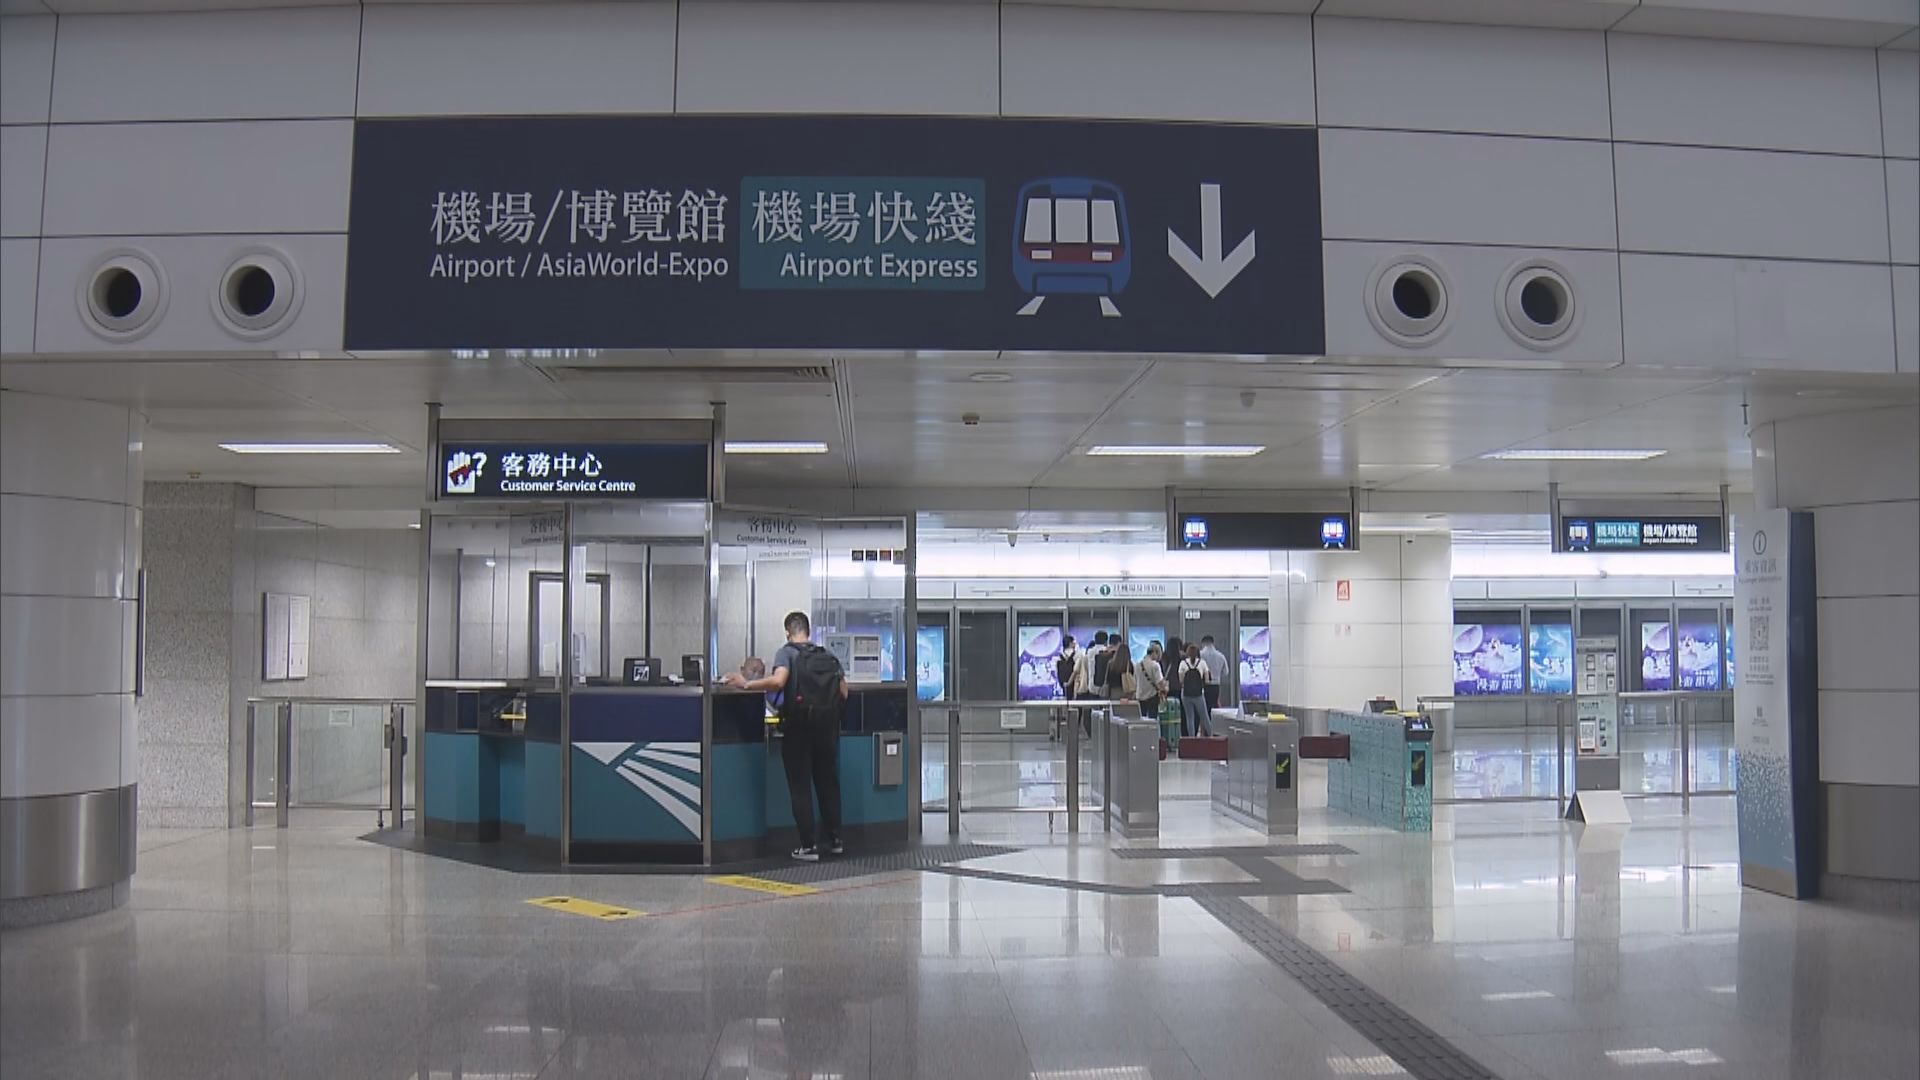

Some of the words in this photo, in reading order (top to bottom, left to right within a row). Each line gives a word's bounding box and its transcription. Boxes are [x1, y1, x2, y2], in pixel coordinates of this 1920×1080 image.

[430, 189, 728, 244] 機場/博覽館
[752, 190, 977, 244] 機場快綫
[430, 254, 515, 283] Airport
[521, 253, 531, 277] /
[537, 252, 729, 282] AsiaWorld-Expo
[780, 252, 873, 282] Airport
[881, 254, 978, 283] Express
[501, 452, 603, 477] 客務中心
[500, 480, 554, 492] Customer
[556, 480, 597, 492] Service
[599, 480, 636, 492] Centre
